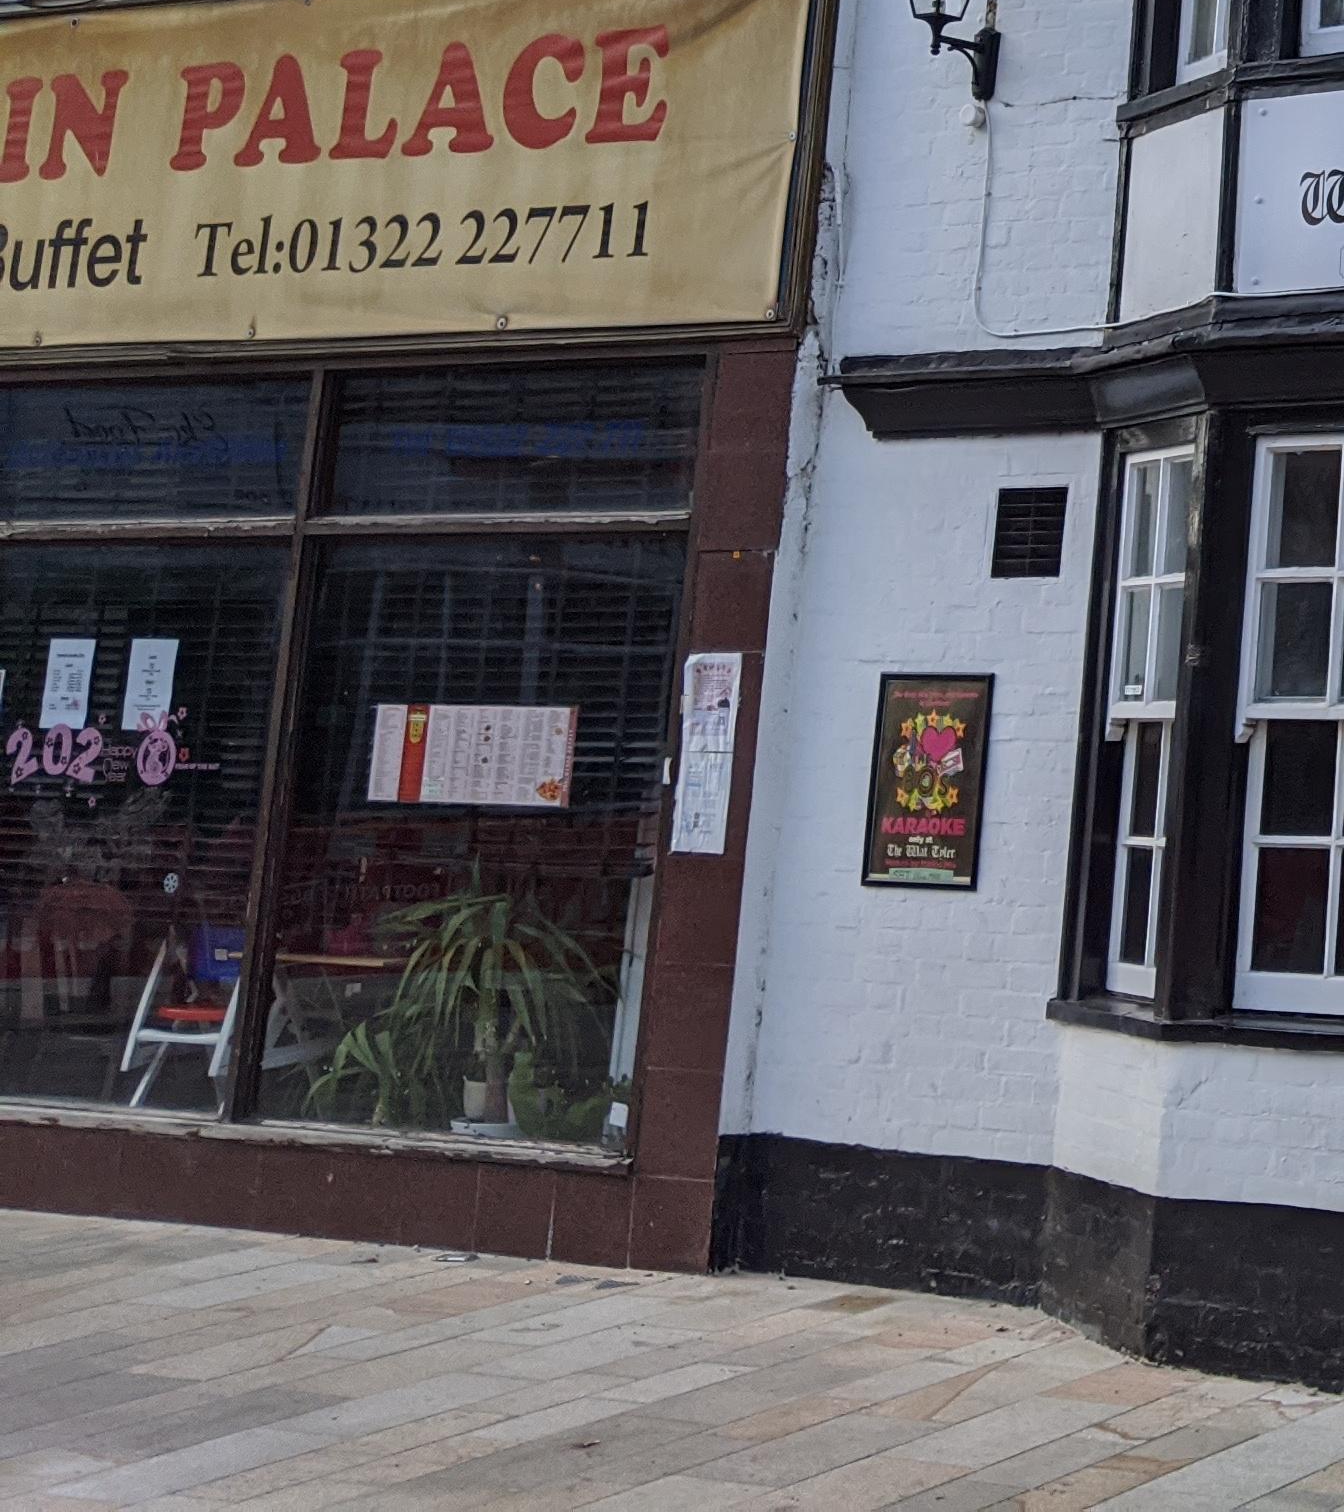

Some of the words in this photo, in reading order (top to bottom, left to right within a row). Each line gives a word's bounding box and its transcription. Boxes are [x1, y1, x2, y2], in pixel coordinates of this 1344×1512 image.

[170, 24, 668, 171] PALACE
[195, 212, 443, 277] Tel:01322
[456, 200, 650, 266] 227711
[881, 817, 966, 836] KARAOKE
[887, 844, 902, 857] The
[906, 845, 927, 857] Wat
[931, 845, 956, 860] Tyler
